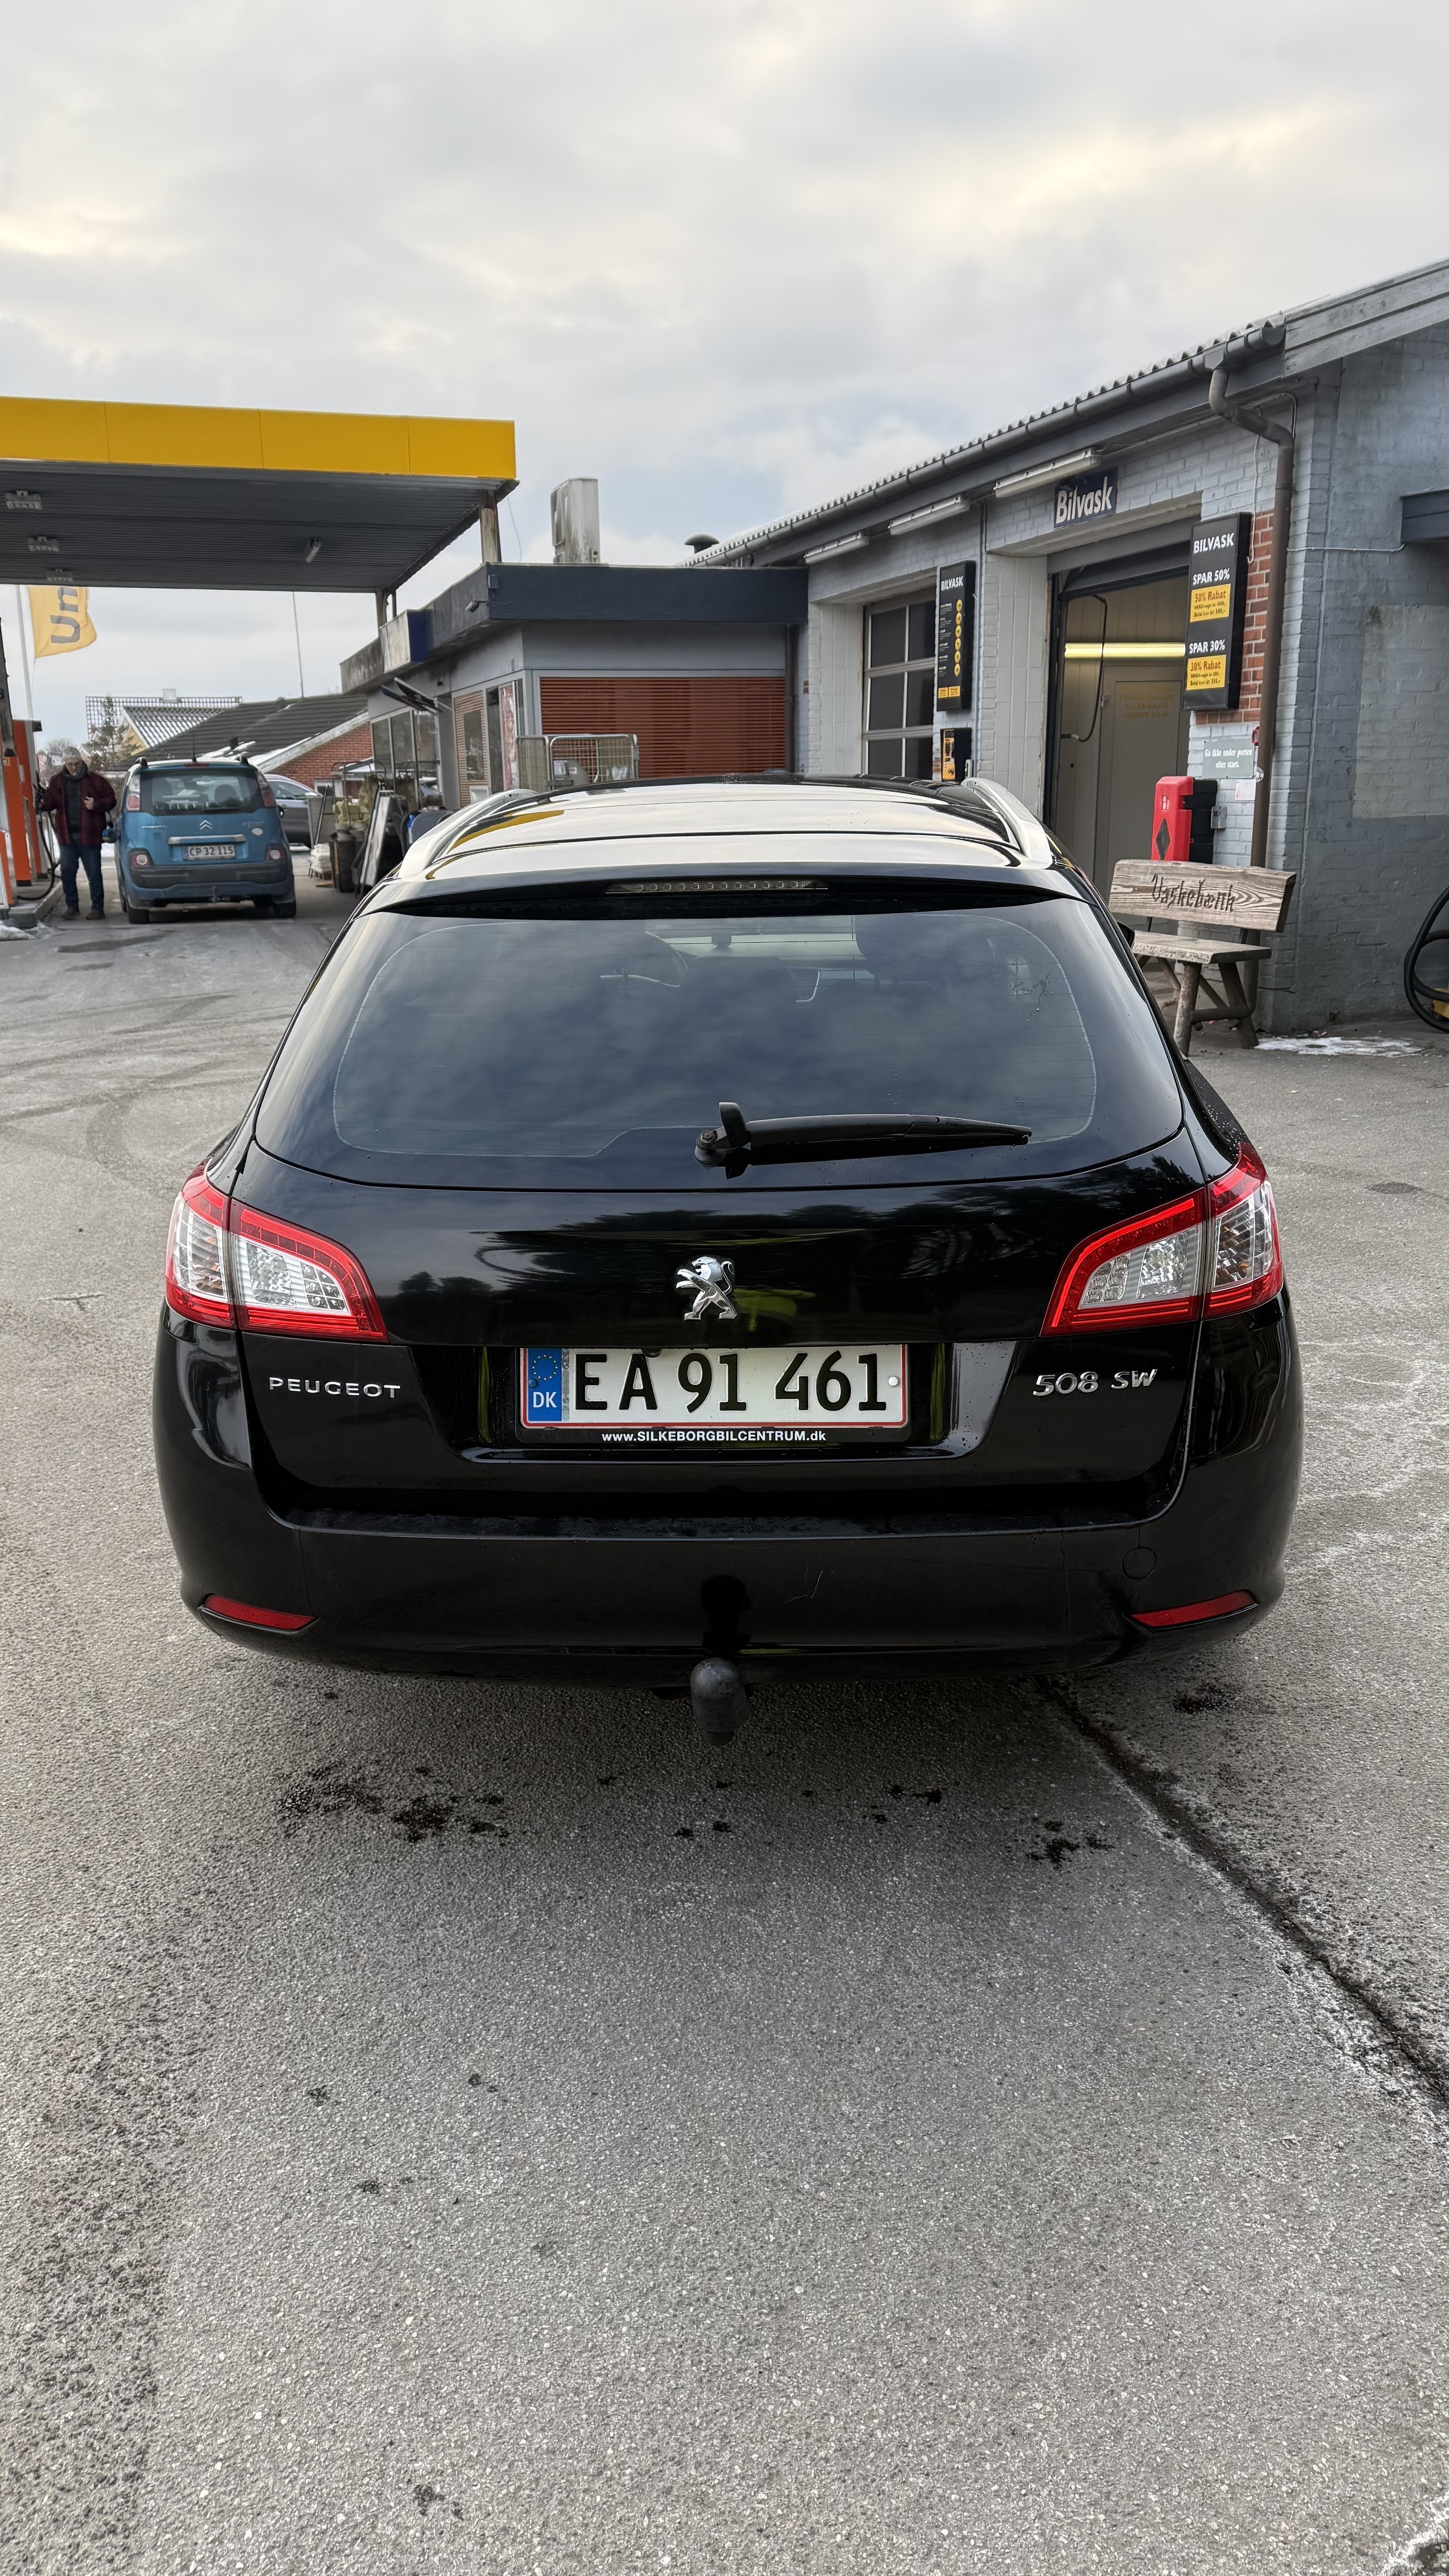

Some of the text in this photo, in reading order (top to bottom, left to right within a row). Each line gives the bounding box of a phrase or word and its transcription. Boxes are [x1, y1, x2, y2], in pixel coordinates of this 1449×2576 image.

[1056, 476, 1113, 524] Bilvask
[1193, 533, 1235, 554] BILVASK
[941, 576, 964, 591] BILVASK
[1193, 568, 1230, 585] SPAR 50%
[1195, 590, 1226, 603] 50% Rabat
[1189, 639, 1225, 654] SPAR 30%
[1191, 660, 1221, 671] 30% Rabat
[1212, 749, 1222, 757] ikke
[1237, 749, 1252, 758] porten
[190, 846, 233, 856] CP 32 115
[269, 1377, 400, 1398] PEUGEOT
[533, 1350, 888, 1413] DK EA 91 461
[1033, 1369, 1158, 1396] 508 SW
[602, 1431, 826, 1442] www.SILKEBORGBILCENTRUM.dk
